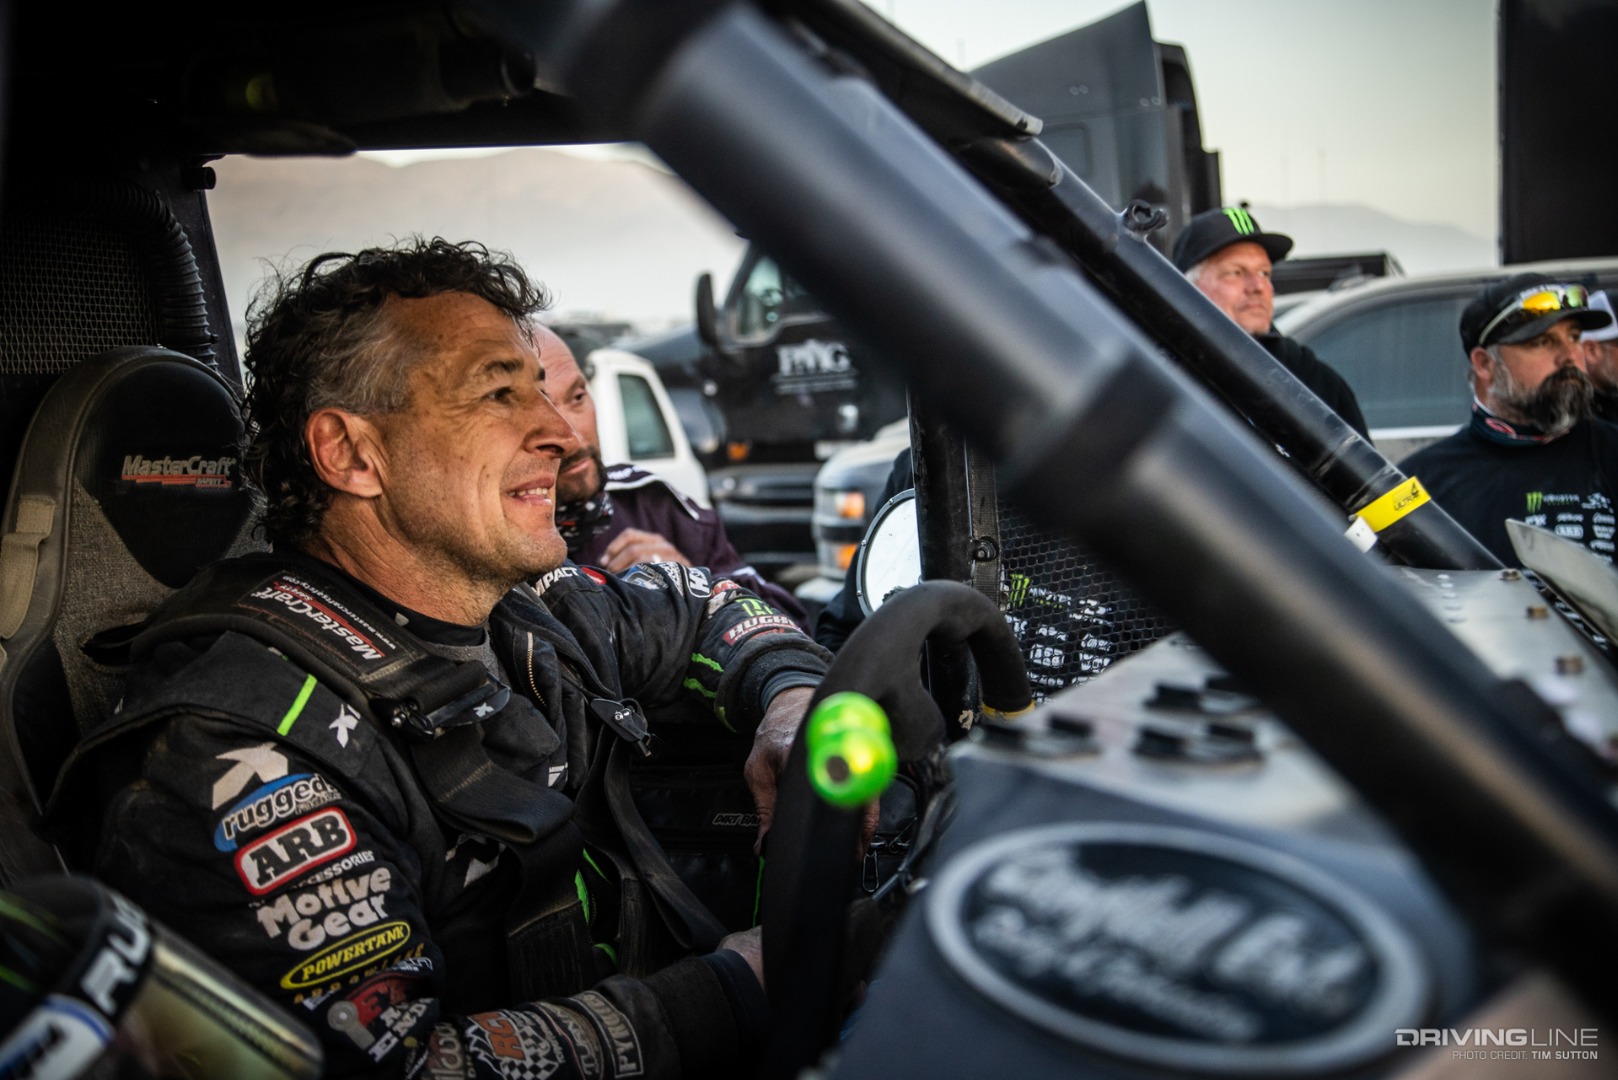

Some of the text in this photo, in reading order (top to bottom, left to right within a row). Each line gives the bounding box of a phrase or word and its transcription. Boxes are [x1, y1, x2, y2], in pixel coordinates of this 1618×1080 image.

[121, 456, 232, 477] MasterCraft
[532, 567, 579, 597] MPACT
[255, 587, 382, 660] MasterCraft
[222, 773, 328, 840] rugged
[249, 815, 347, 886] ARB
[257, 867, 391, 938] Motive
[287, 893, 389, 950] Gear
[302, 925, 405, 981] POWERTANK
